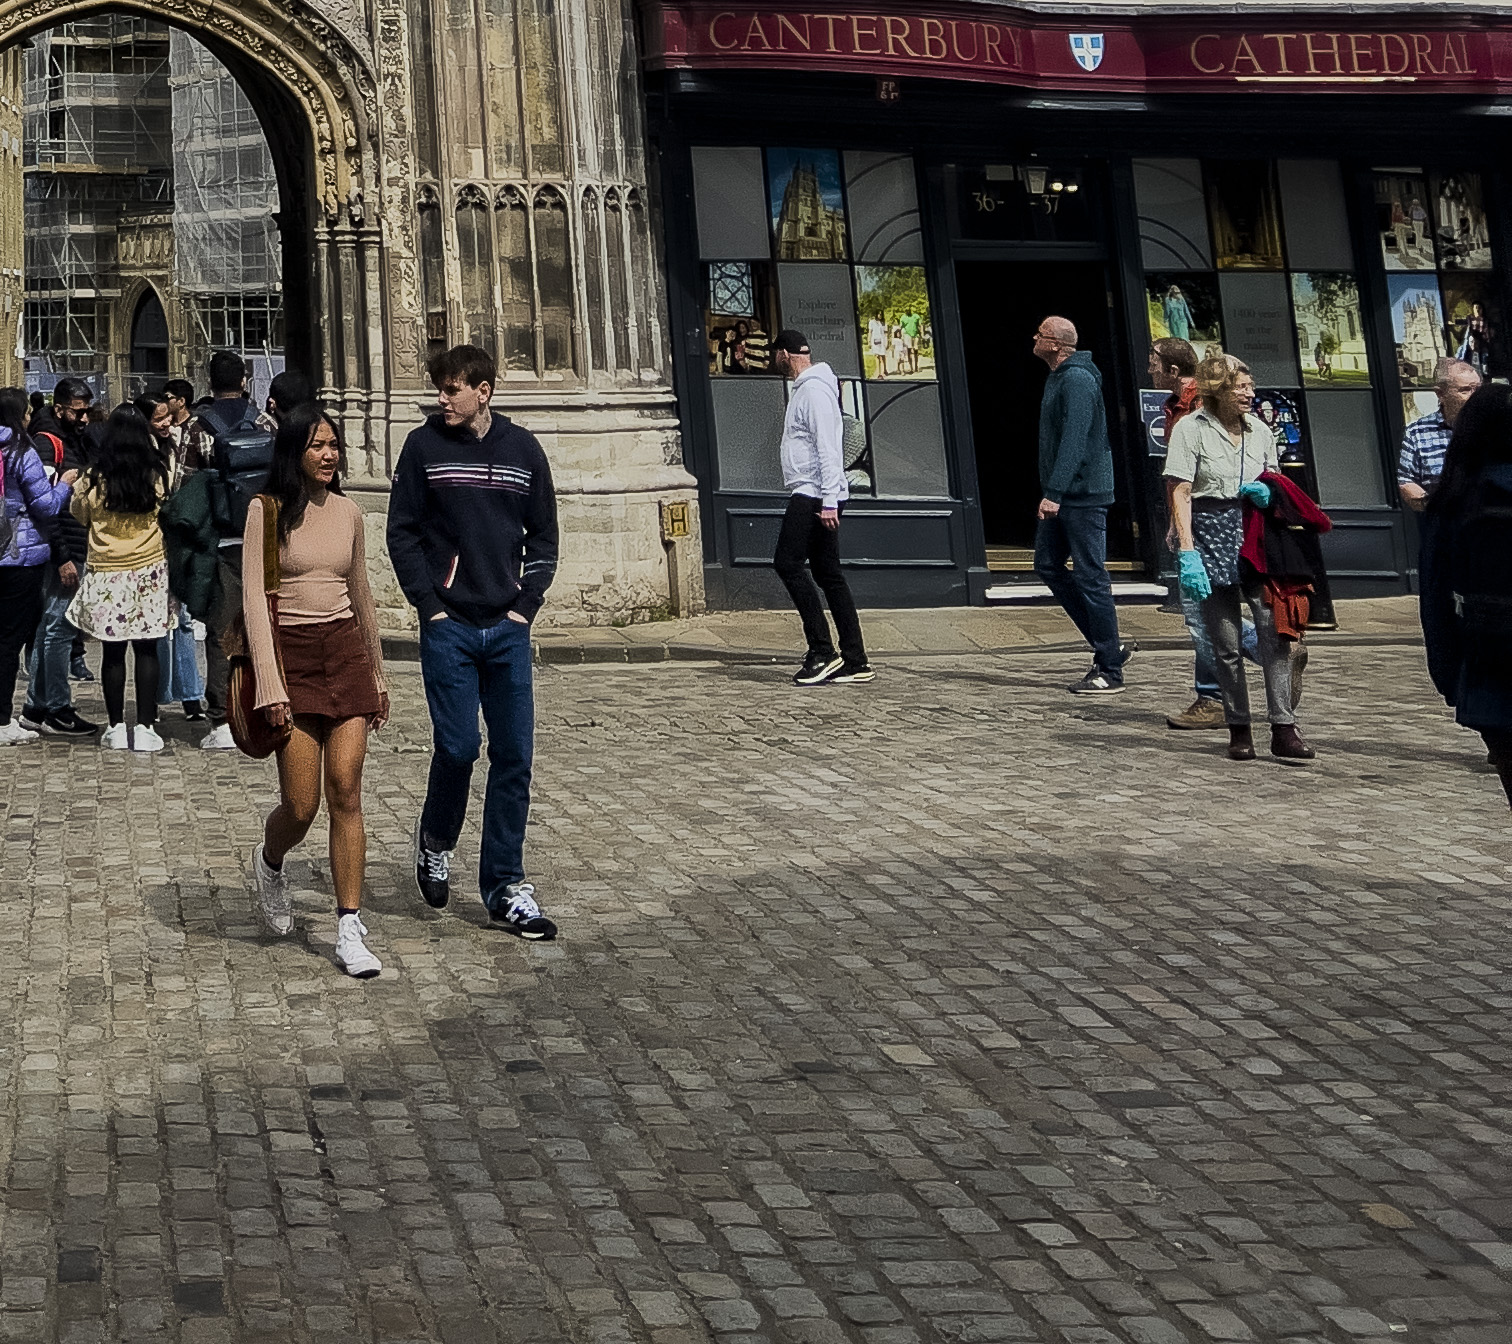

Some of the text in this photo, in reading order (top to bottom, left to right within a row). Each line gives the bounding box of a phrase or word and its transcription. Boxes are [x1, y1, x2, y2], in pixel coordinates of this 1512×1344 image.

[709, 12, 1477, 75] CANTERBURY CATHEDRAL
[798, 298, 838, 312] Explore
[789, 315, 846, 328] Canterbury
[808, 331, 845, 342] thedral
[1143, 403, 1161, 412] Exit
